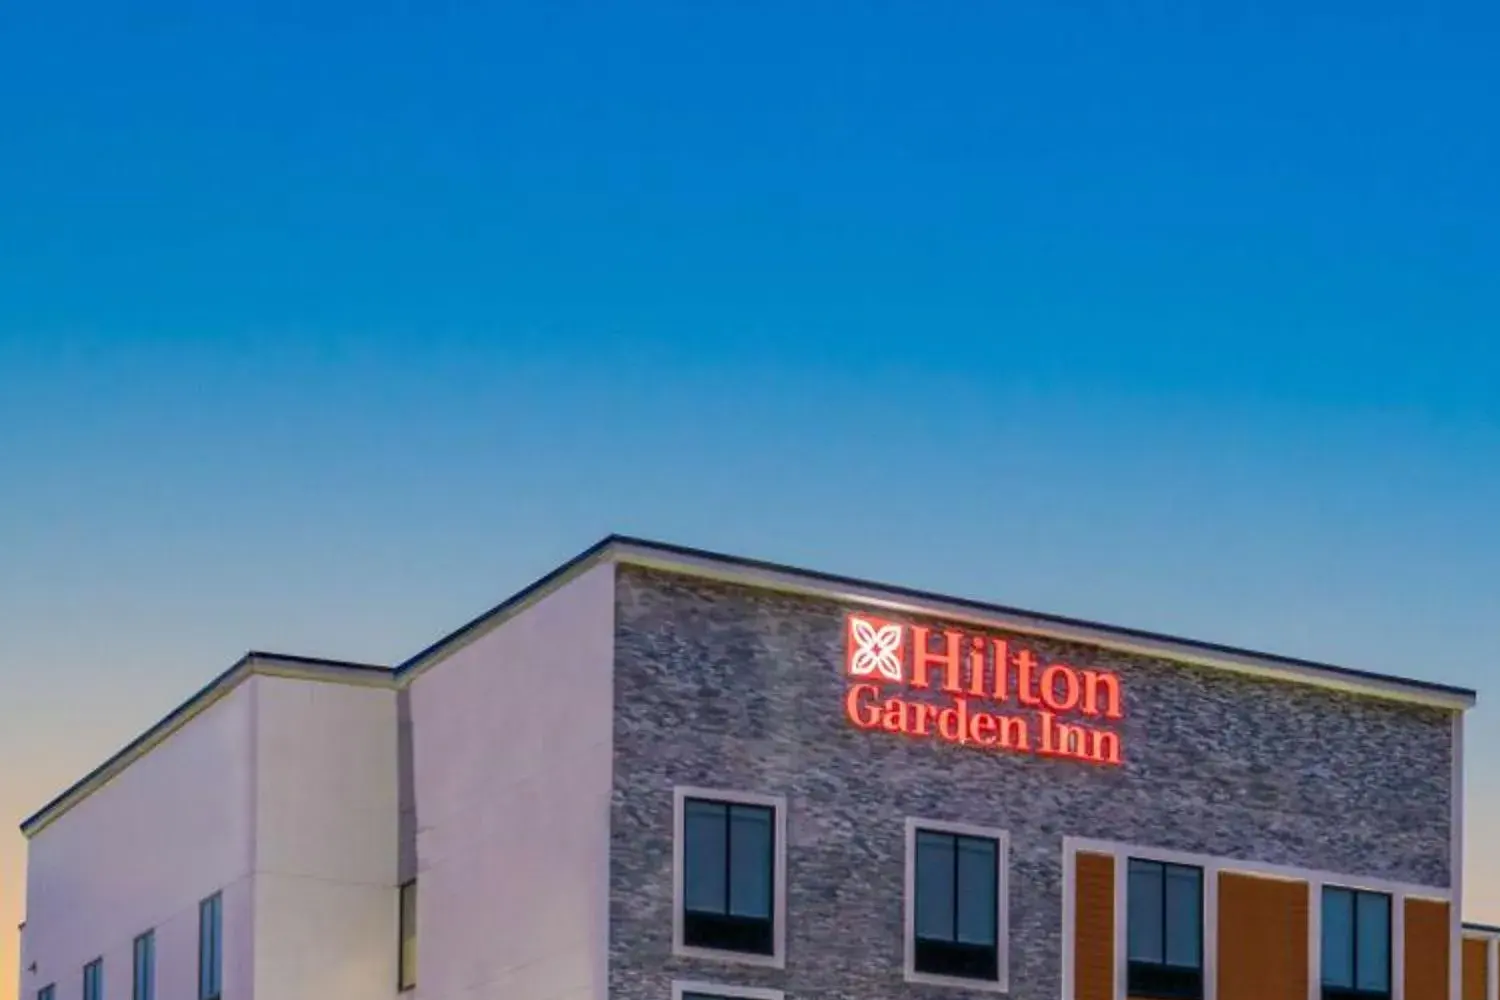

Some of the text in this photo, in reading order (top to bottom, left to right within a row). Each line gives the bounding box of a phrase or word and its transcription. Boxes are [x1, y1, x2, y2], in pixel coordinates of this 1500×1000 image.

[909, 623, 1122, 719] Hilton
[846, 682, 1122, 765] Garden Inn
